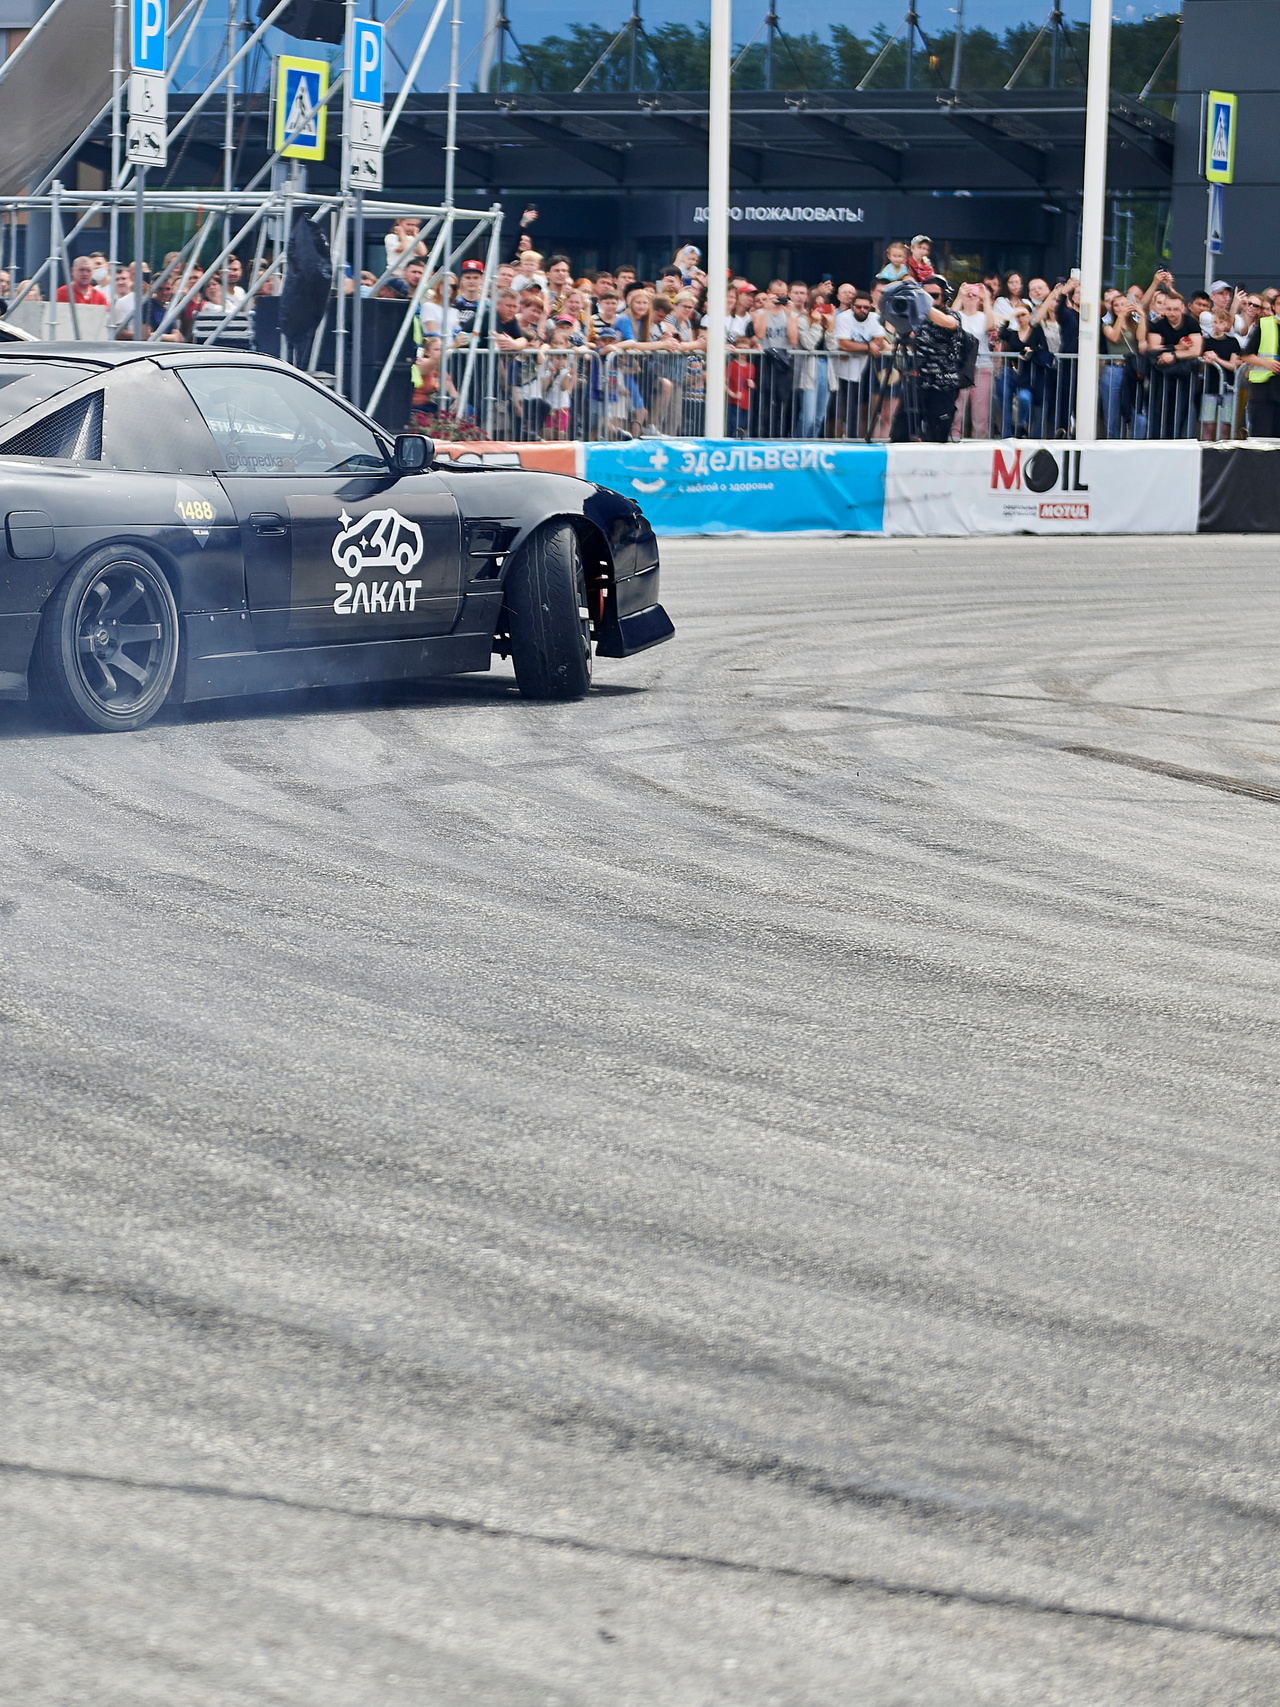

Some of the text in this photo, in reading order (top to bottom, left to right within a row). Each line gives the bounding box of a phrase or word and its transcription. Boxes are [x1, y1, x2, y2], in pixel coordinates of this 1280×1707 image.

[140, 0, 162, 60] P
[359, 30, 380, 93] P
[745, 207, 864, 223] ПОЖАЛОВАТЬ!
[990, 448, 1089, 493] MOIL
[720, 483, 727, 492] о
[729, 482, 775, 492] здоровье
[177, 501, 214, 520] 1488
[1041, 503, 1088, 518] MOTUL
[333, 580, 423, 615] ZAKAT
